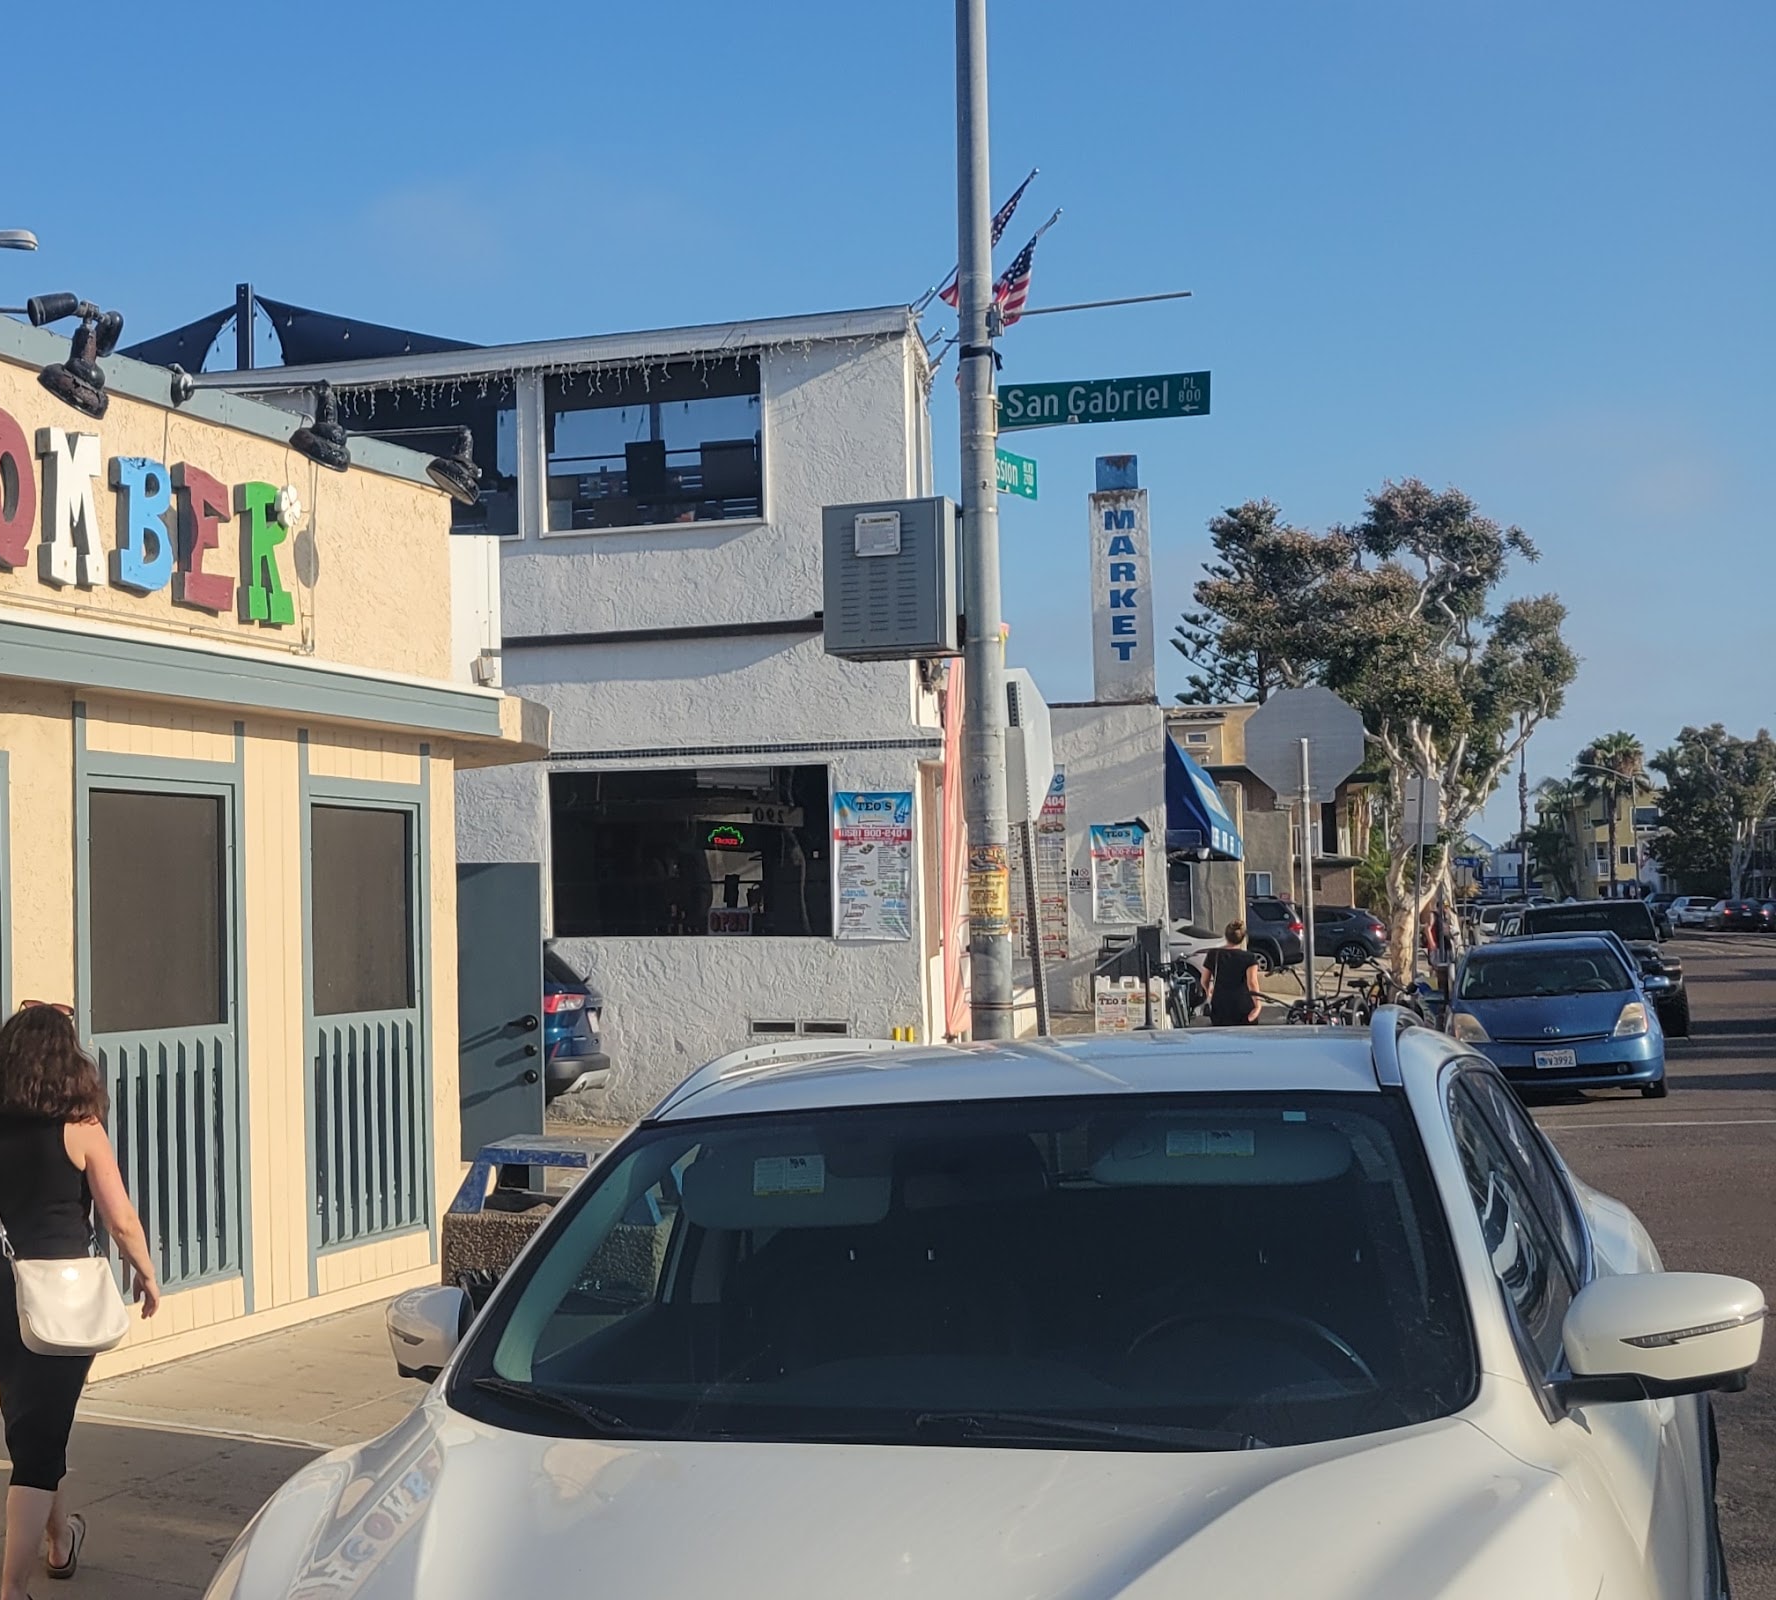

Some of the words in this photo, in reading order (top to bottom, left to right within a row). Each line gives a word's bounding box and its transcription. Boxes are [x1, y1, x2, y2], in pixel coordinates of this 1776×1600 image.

[1178, 389, 1201, 402] 800
[1183, 377, 1196, 389] PL
[1007, 387, 1058, 418] San
[1068, 380, 1168, 416] Gabriel
[995, 456, 1018, 487] ssion
[1104, 510, 1137, 661] MARKET
[710, 911, 750, 932] OPEN
